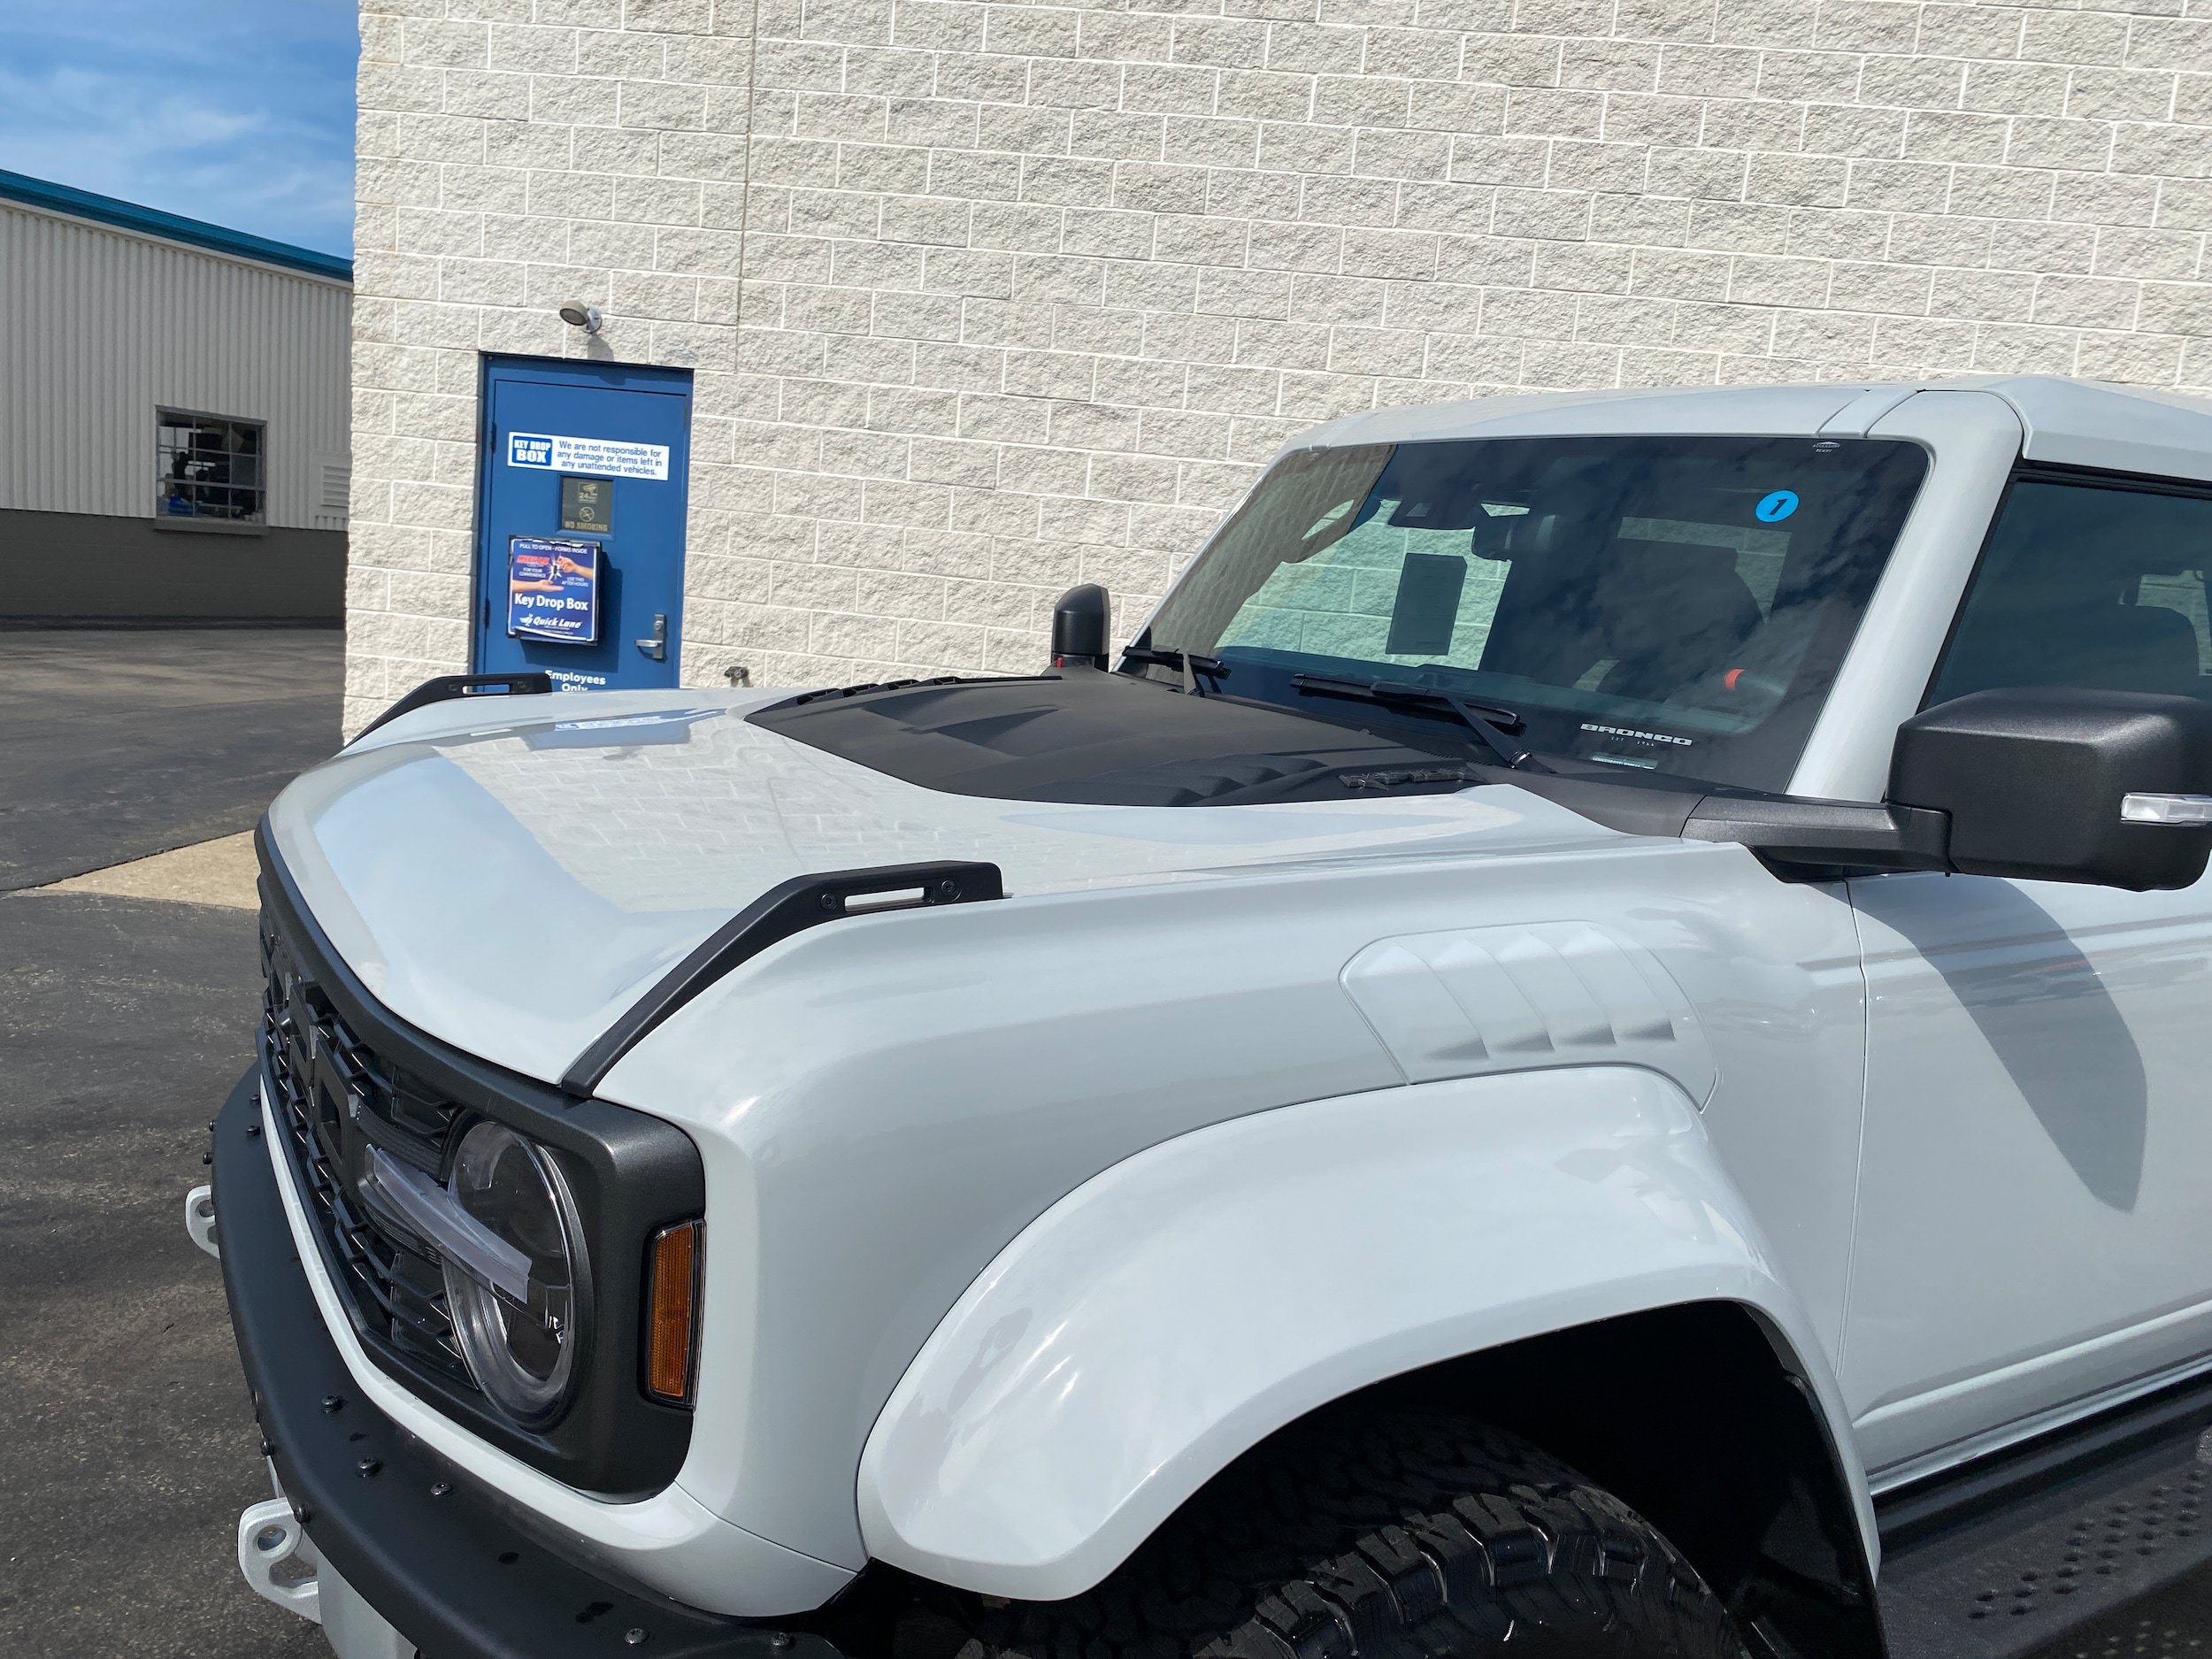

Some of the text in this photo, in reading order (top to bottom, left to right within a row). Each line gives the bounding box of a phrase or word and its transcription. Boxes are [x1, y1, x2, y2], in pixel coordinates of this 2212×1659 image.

[514, 440, 551, 451] KEY DROP
[559, 441, 572, 449] We
[603, 446, 648, 456] responsible
[650, 449, 662, 457] for
[516, 449, 547, 463] BOX
[557, 450, 572, 459] any
[573, 451, 604, 463] damage
[617, 455, 638, 465] items
[640, 457, 653, 465] left
[561, 460, 657, 475] any unattended vehicles.
[1770, 498, 1788, 516] 1
[576, 522, 608, 532] SMOKING
[514, 593, 588, 611] Key Drop Box
[533, 616, 581, 628] Quick Lane
[545, 670, 606, 686] Employees
[1580, 723, 1693, 746] BRONCO
